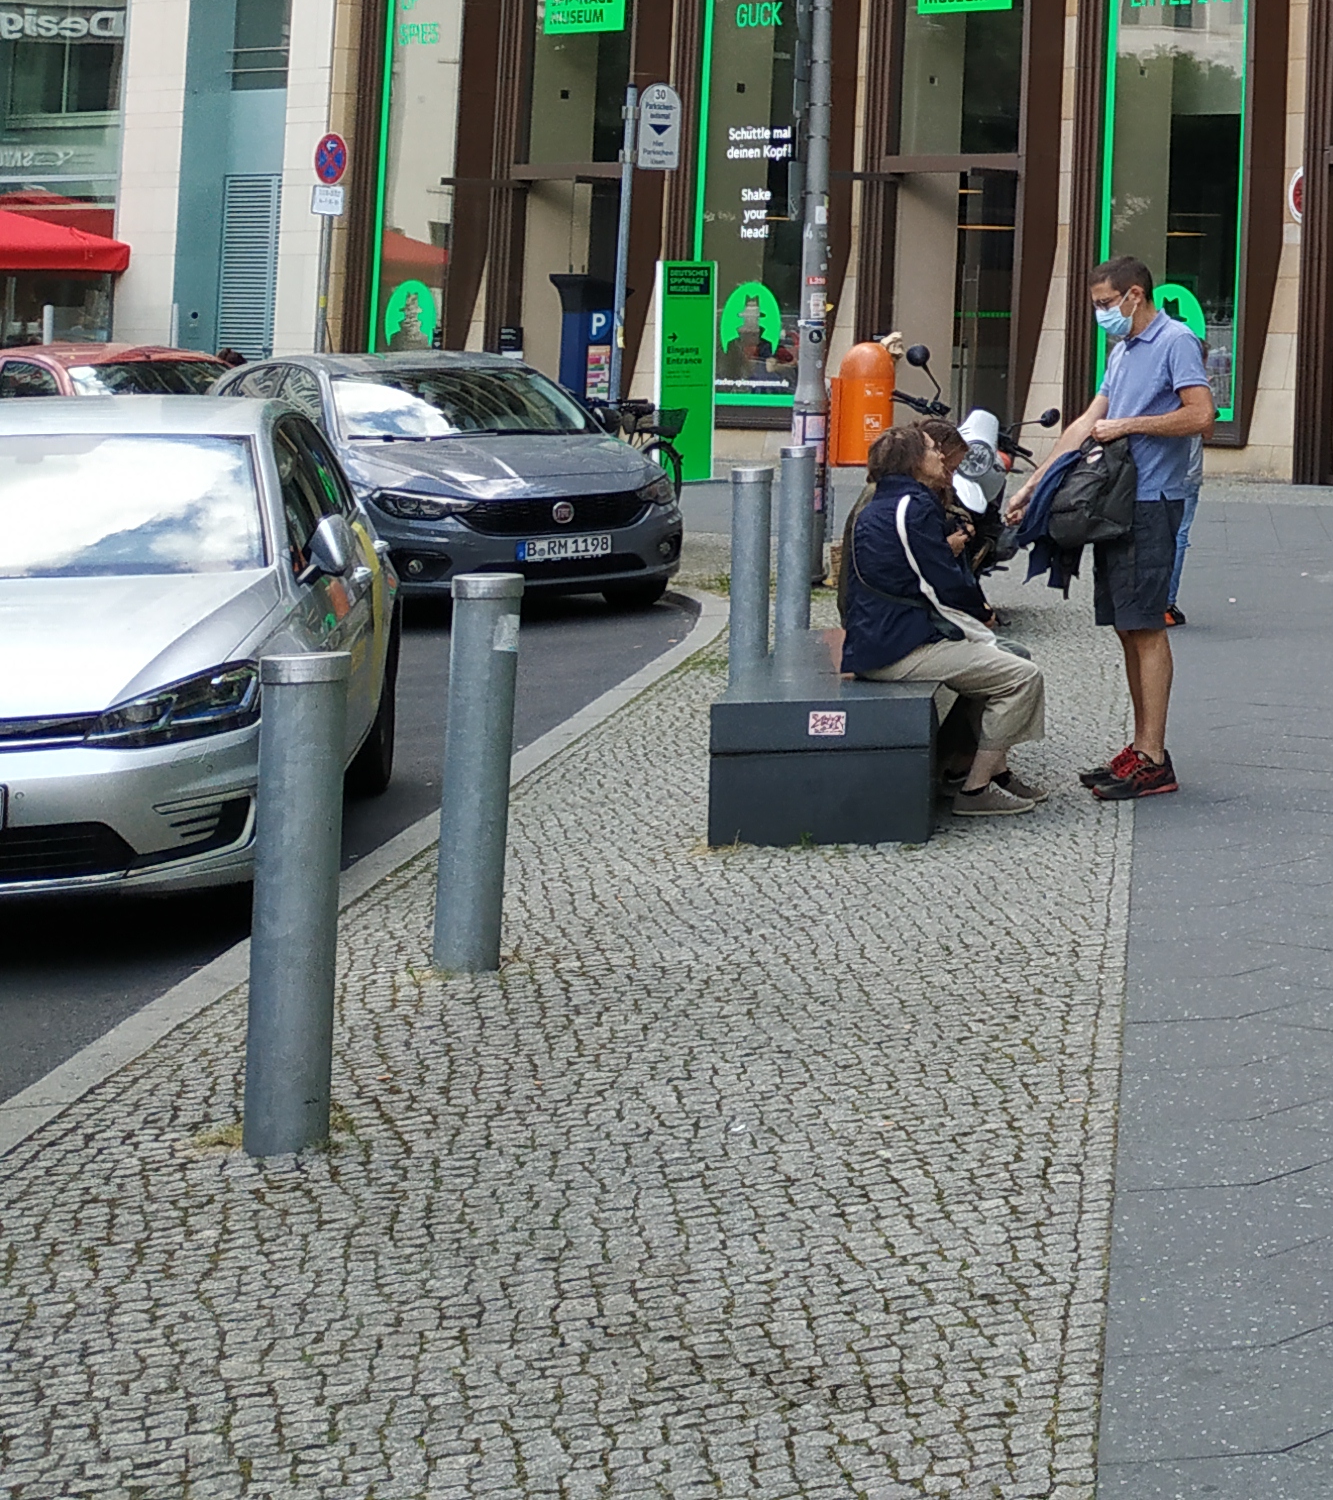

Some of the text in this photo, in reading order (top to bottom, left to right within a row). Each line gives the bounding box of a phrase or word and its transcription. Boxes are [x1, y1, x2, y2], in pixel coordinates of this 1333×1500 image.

[549, 8, 604, 25] MUSEUM
[736, 1, 783, 28] GUCK
[398, 21, 440, 46] SPIES
[655, 89, 666, 100] 30
[728, 125, 791, 141] Schüttle mal
[726, 143, 792, 161] deinen Kopf!
[741, 188, 771, 201] Shake
[743, 208, 768, 224] your
[740, 225, 770, 239] head!
[669, 269, 708, 277] DEUTSCHES
[592, 313, 606, 336] P
[666, 346, 700, 356] Eingang
[666, 356, 702, 366] Entrance
[526, 536, 609, 557] B RM 1198
